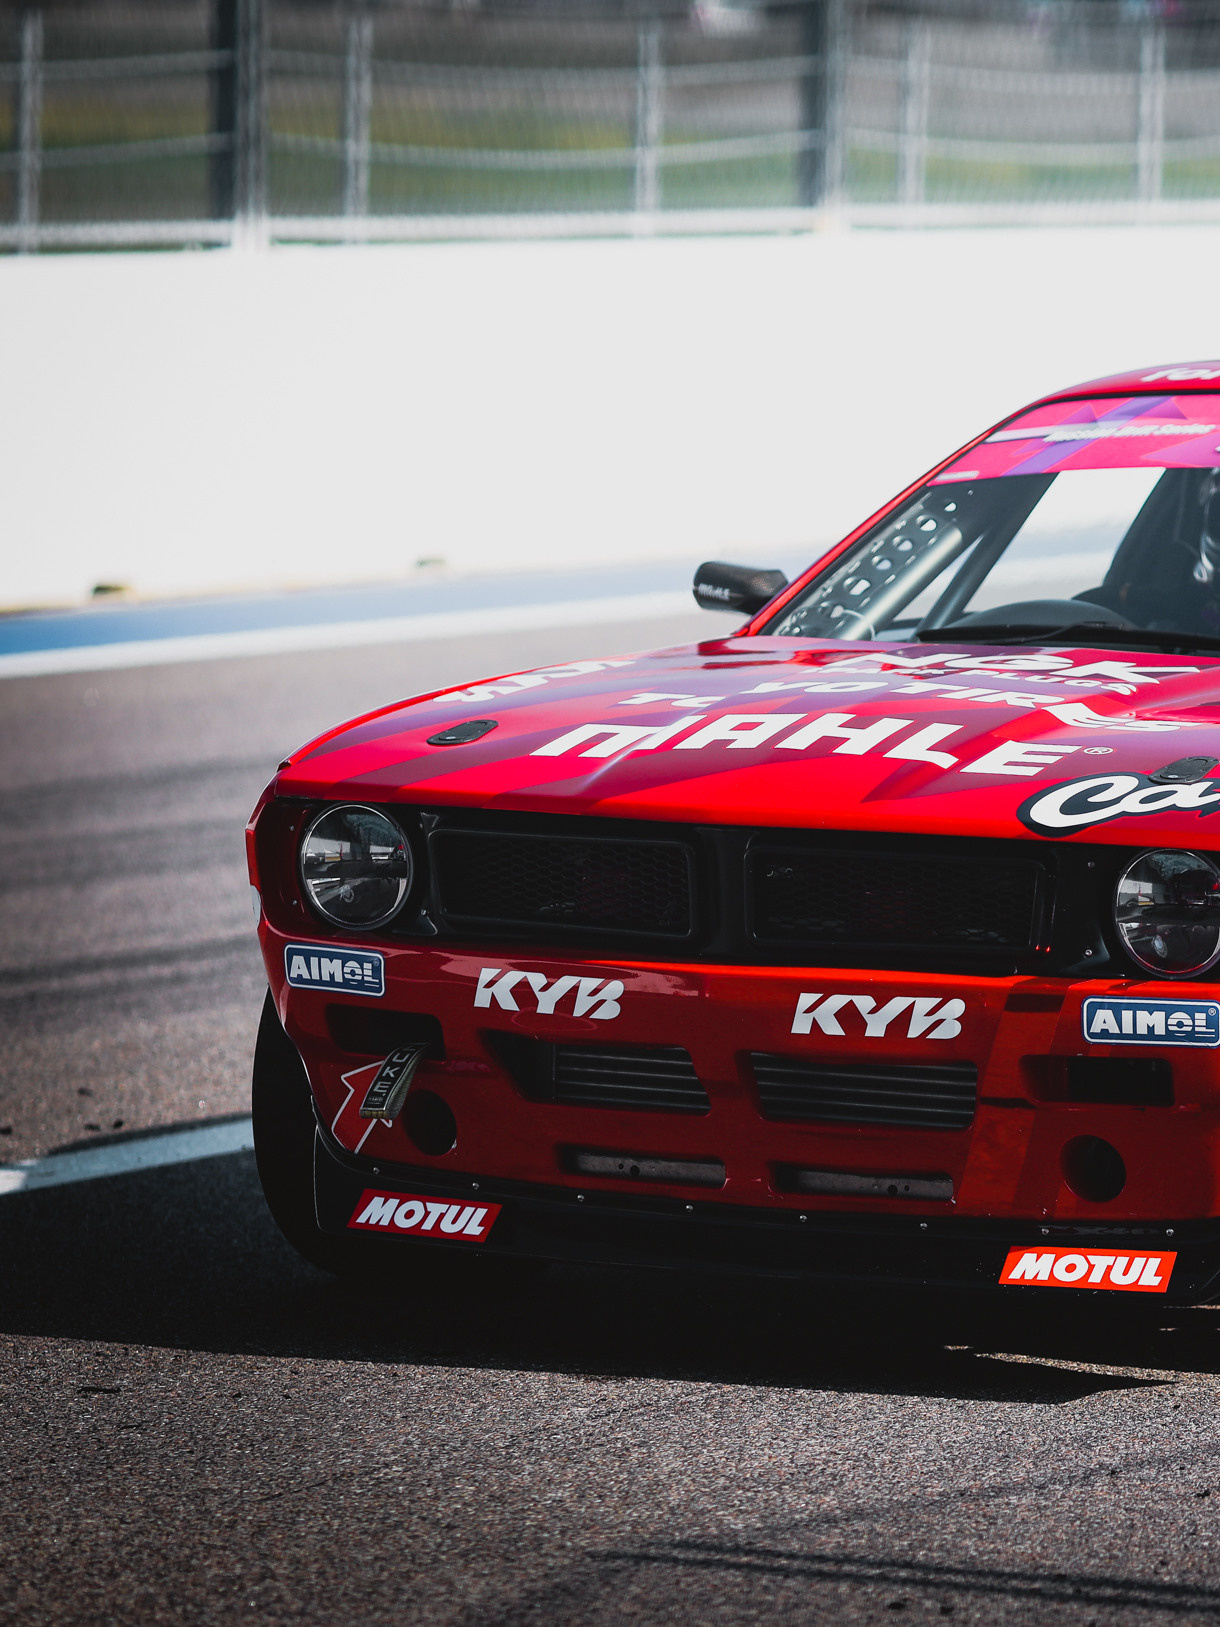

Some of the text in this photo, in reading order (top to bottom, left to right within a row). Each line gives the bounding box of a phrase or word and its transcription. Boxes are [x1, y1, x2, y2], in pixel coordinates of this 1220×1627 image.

[820, 651, 1202, 686] NGK
[889, 681, 1203, 732] TIRES
[474, 967, 626, 1021] KYB
[790, 993, 966, 1039] KYB
[355, 1196, 488, 1236] MOTUL
[1007, 1253, 1163, 1287] MOTUL
